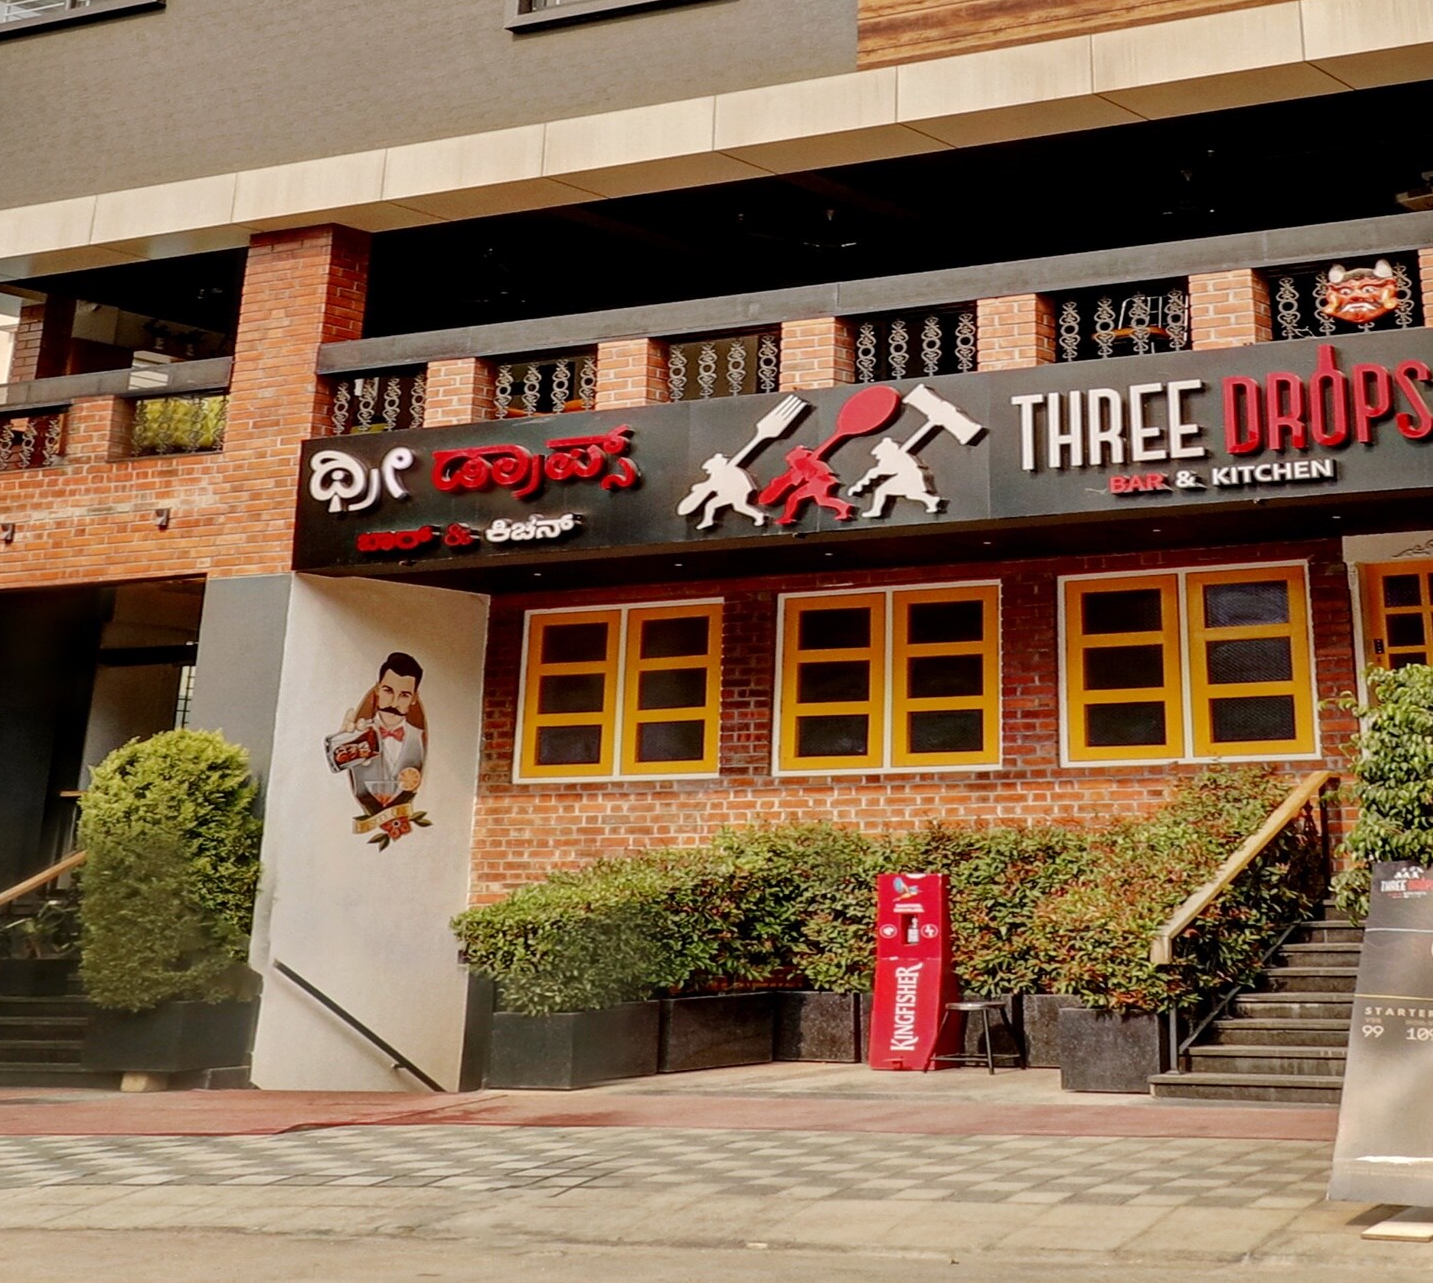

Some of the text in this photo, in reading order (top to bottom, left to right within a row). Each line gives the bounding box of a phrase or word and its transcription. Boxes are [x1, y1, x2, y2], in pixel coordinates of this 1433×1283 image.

[1011, 379, 1207, 471] THREE
[1109, 458, 1335, 495] BAR & KITCHEN
[889, 962, 924, 1052] KINGFISHER
[1362, 1025, 1384, 1038] 99
